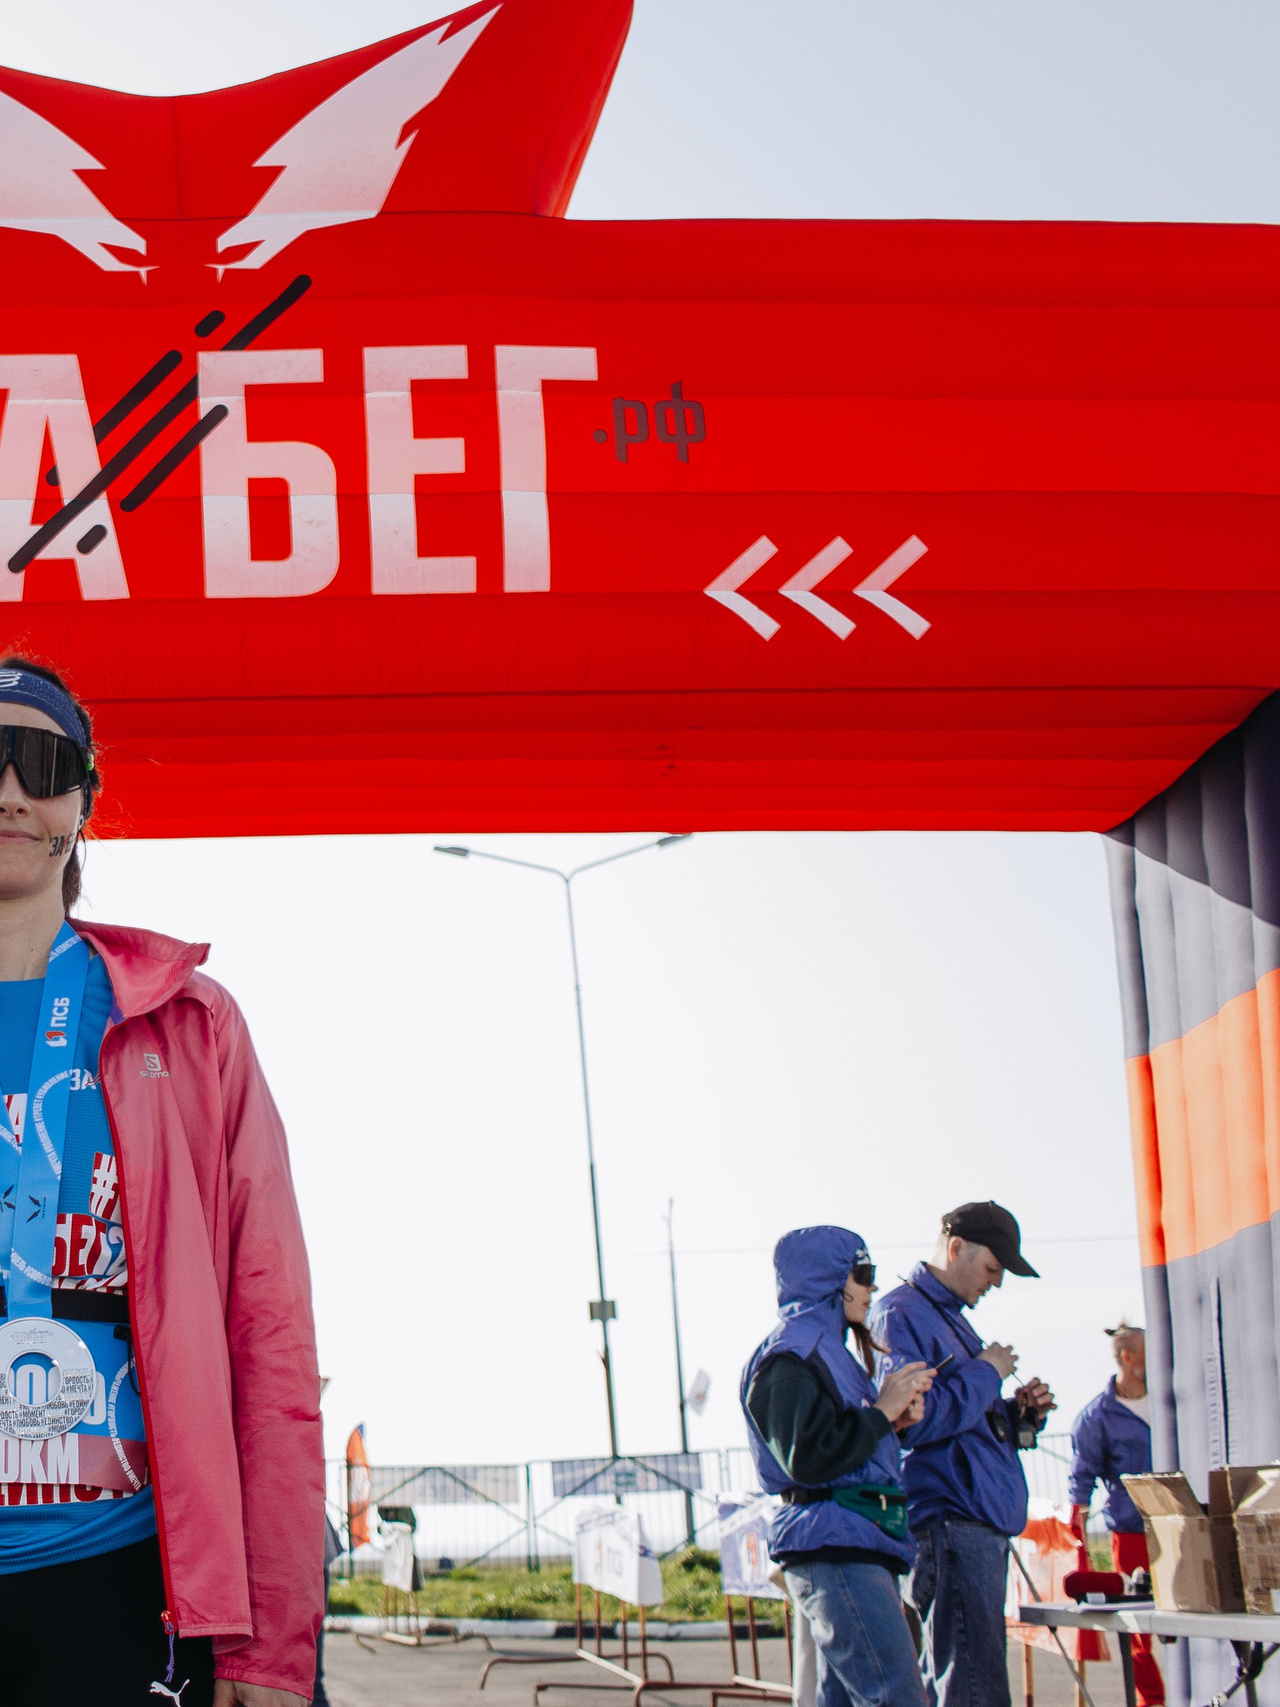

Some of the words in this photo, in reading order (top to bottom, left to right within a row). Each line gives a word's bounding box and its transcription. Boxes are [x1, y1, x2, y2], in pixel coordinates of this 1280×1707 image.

[50, 997, 70, 1028] ПСБ
[23, 1265, 53, 1287] #СВОБОД
[107, 1404, 118, 1438] #ГОРДОСТЬ
[112, 1435, 131, 1472] #ЕДИНСТВО
[126, 1467, 141, 1491] #МЕЧТА
